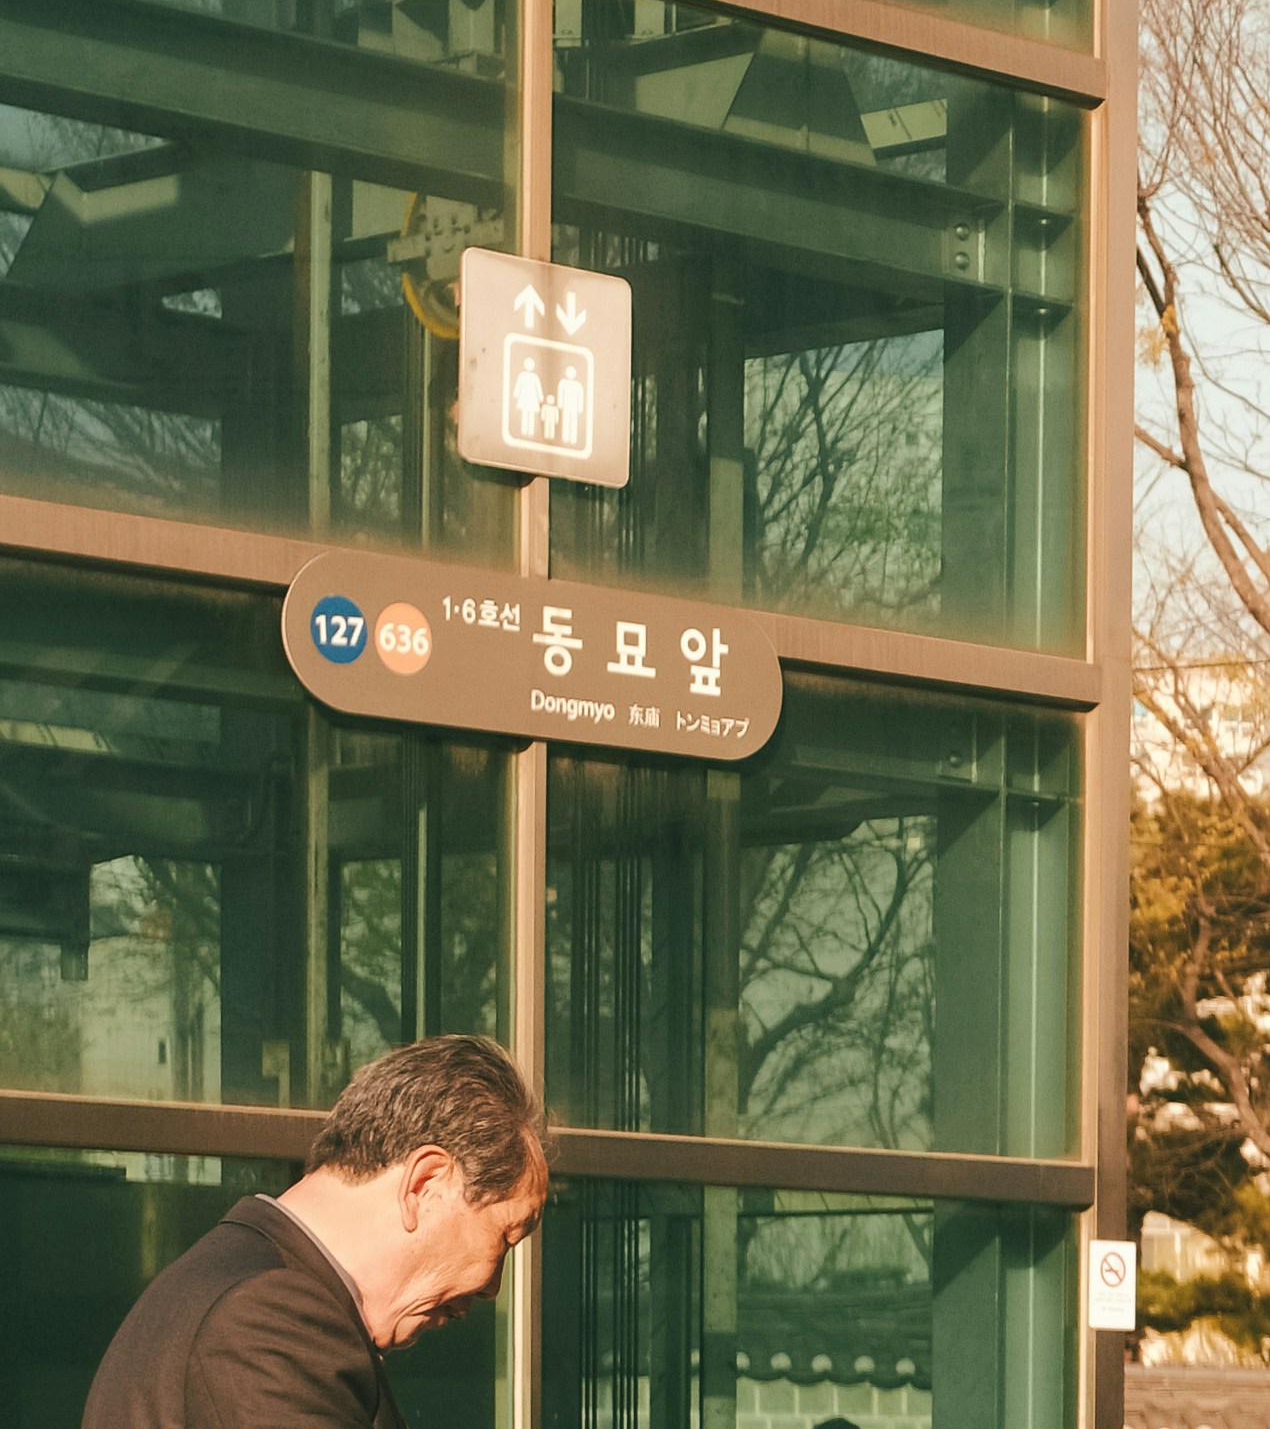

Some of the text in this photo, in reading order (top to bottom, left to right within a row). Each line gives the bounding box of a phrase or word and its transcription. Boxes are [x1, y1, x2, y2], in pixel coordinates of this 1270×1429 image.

[315, 612, 364, 647] 127
[378, 623, 430, 657] 636
[531, 689, 617, 722] Dongmyo
